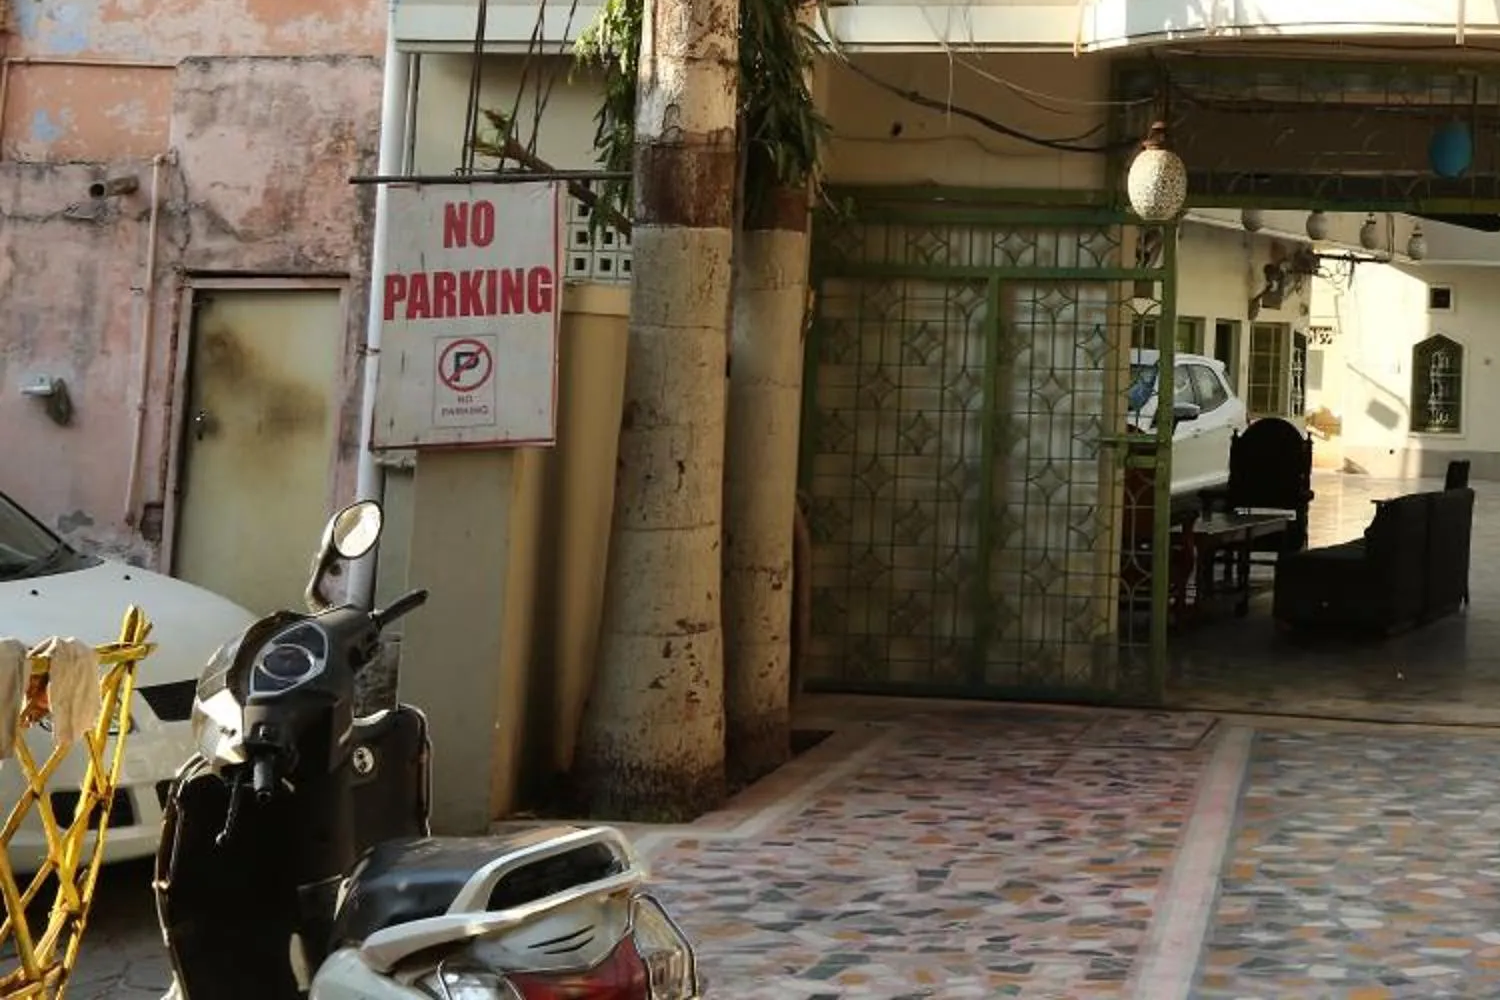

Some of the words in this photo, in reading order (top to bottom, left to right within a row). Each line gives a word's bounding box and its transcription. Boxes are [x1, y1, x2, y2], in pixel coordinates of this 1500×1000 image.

[443, 200, 495, 248] NO
[383, 267, 553, 320] PARKING
[454, 351, 480, 382] P
